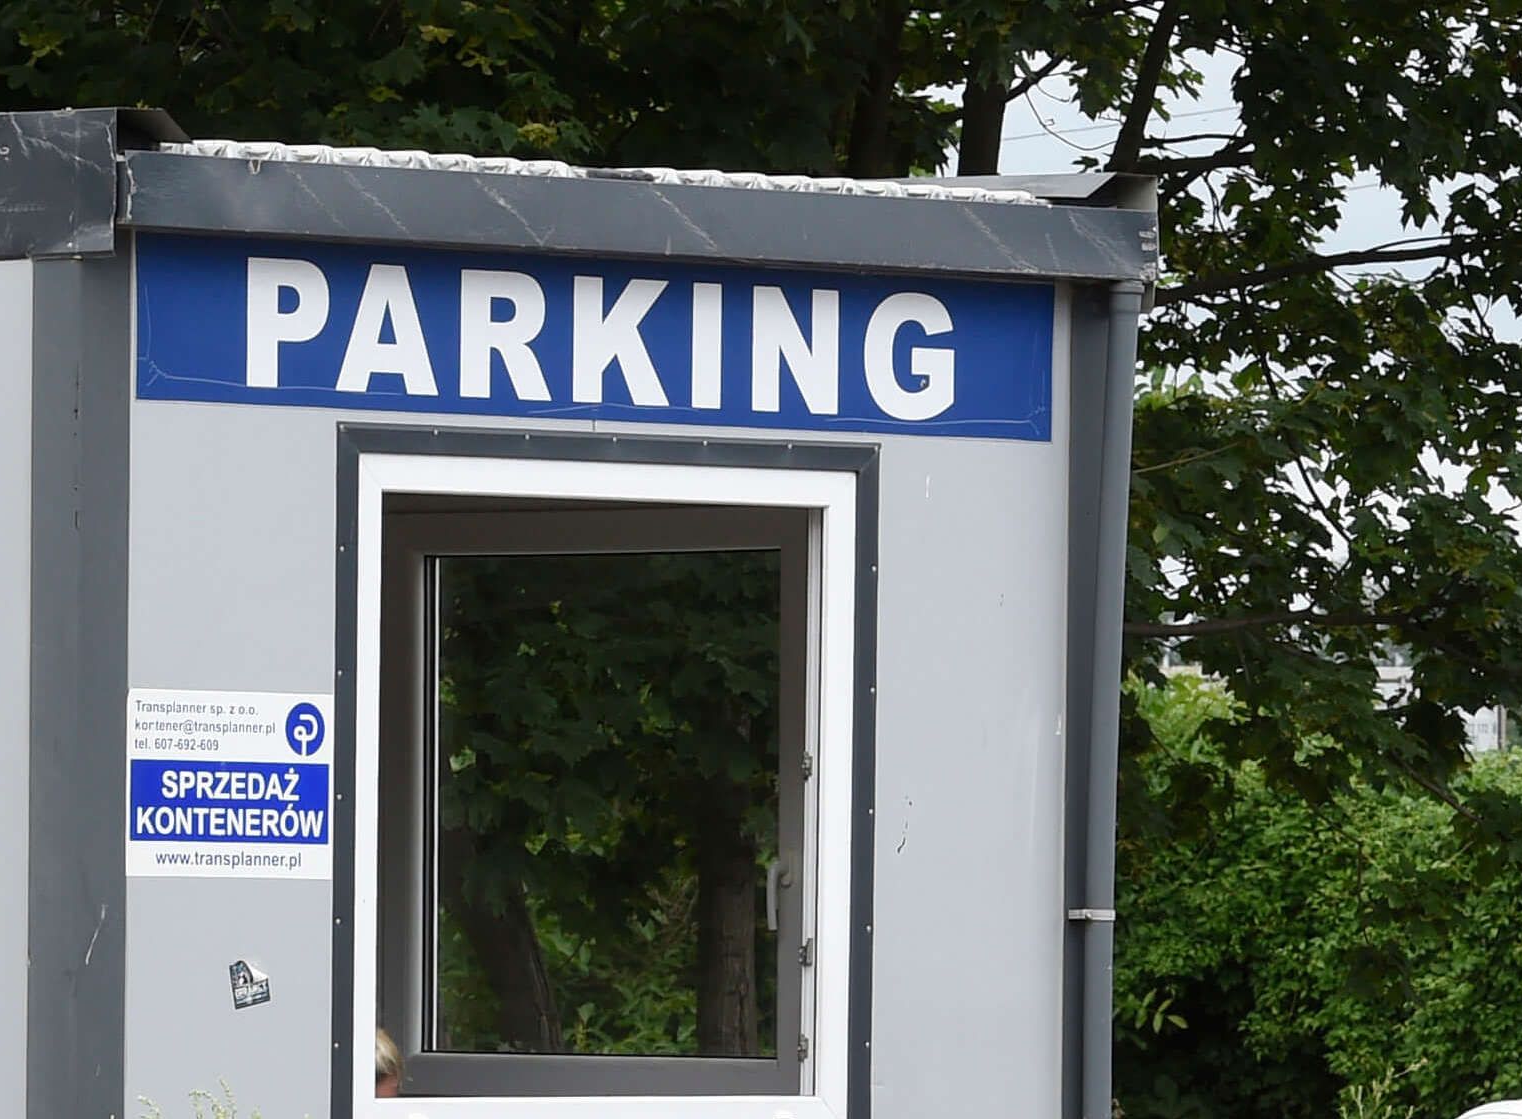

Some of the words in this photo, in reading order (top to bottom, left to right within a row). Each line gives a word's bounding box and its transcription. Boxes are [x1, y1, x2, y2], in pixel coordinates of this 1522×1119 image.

[246, 256, 956, 420] PARKING
[136, 700, 206, 715] Transplanner
[210, 707, 225, 716] sp.
[229, 706, 235, 715] z
[238, 706, 258, 715] o.o.
[134, 737, 152, 750] tel.
[161, 767, 300, 801] SPRZEDAŻ
[136, 804, 324, 838] KONTENERÓW
[155, 852, 302, 870] www.transplanner.pl
